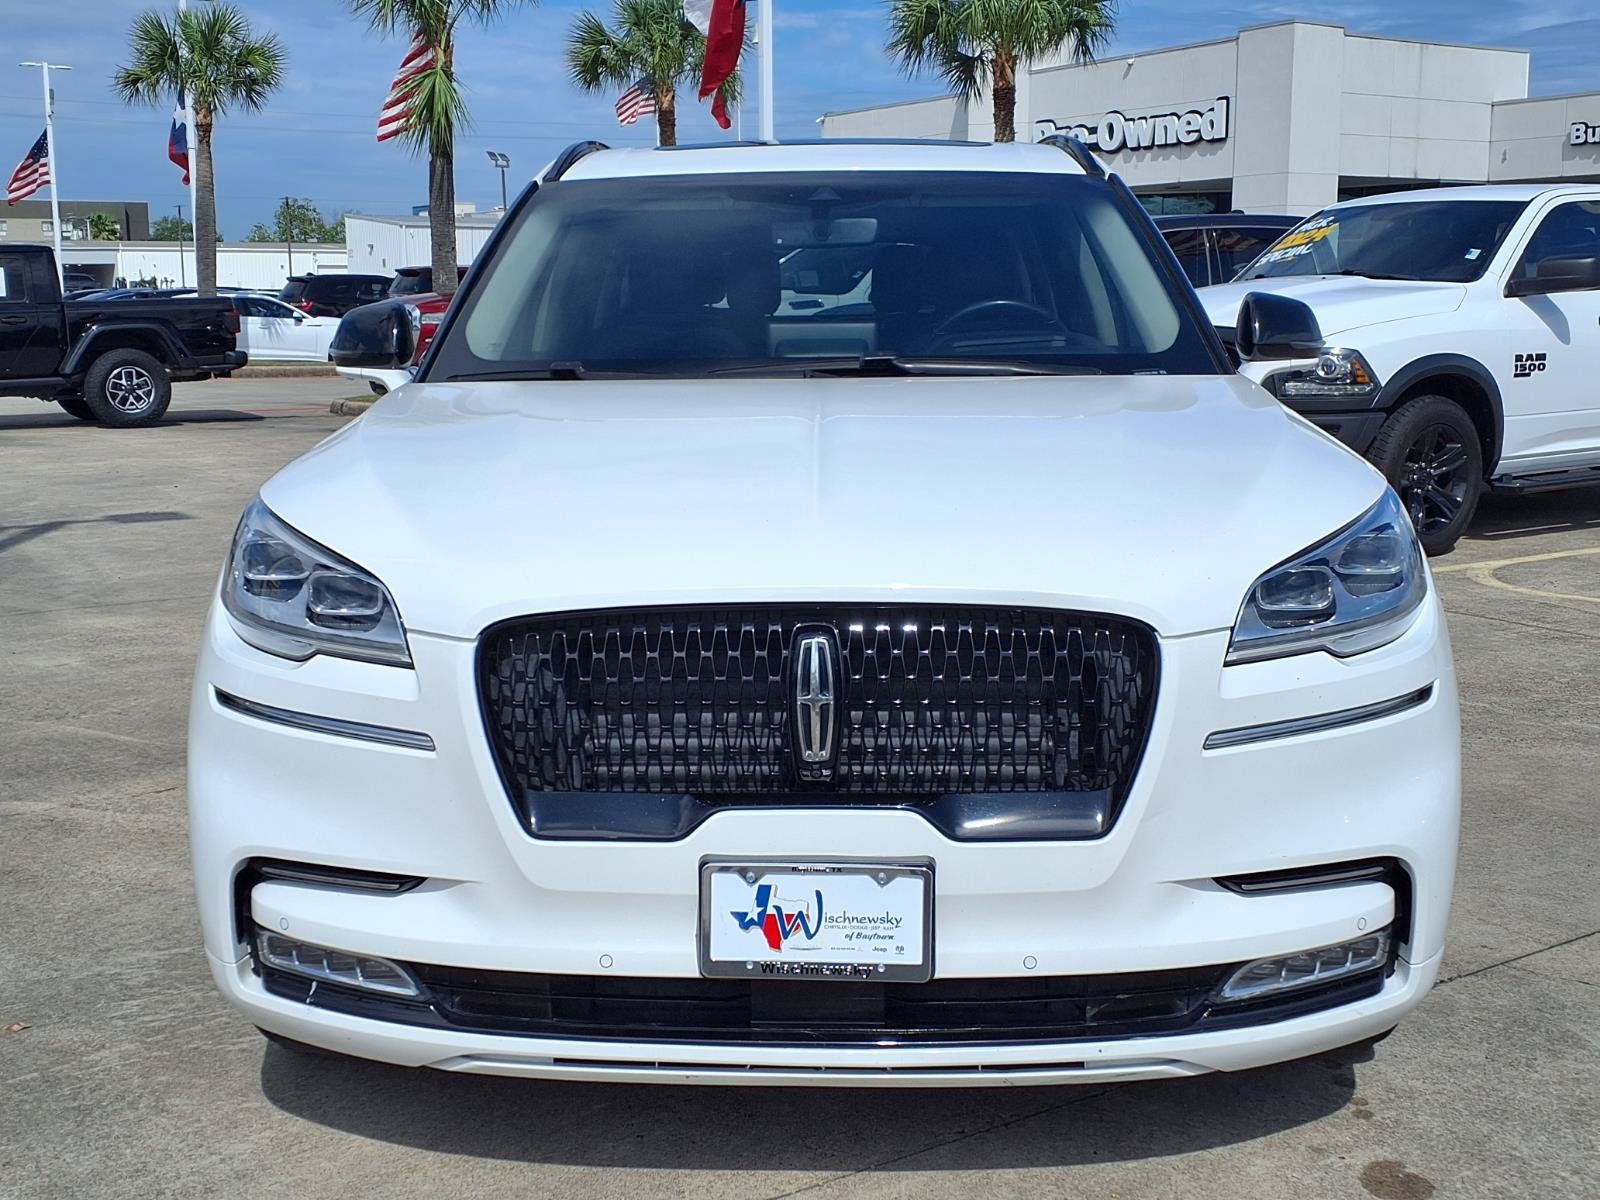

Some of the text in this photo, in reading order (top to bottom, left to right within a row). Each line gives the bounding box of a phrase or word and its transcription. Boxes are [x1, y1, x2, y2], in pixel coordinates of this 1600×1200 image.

[1514, 353, 1547, 363] RAM
[1514, 362, 1547, 373] 1500
[844, 931, 895, 941] of Baytown
[760, 960, 873, 979] Wischnewsky
